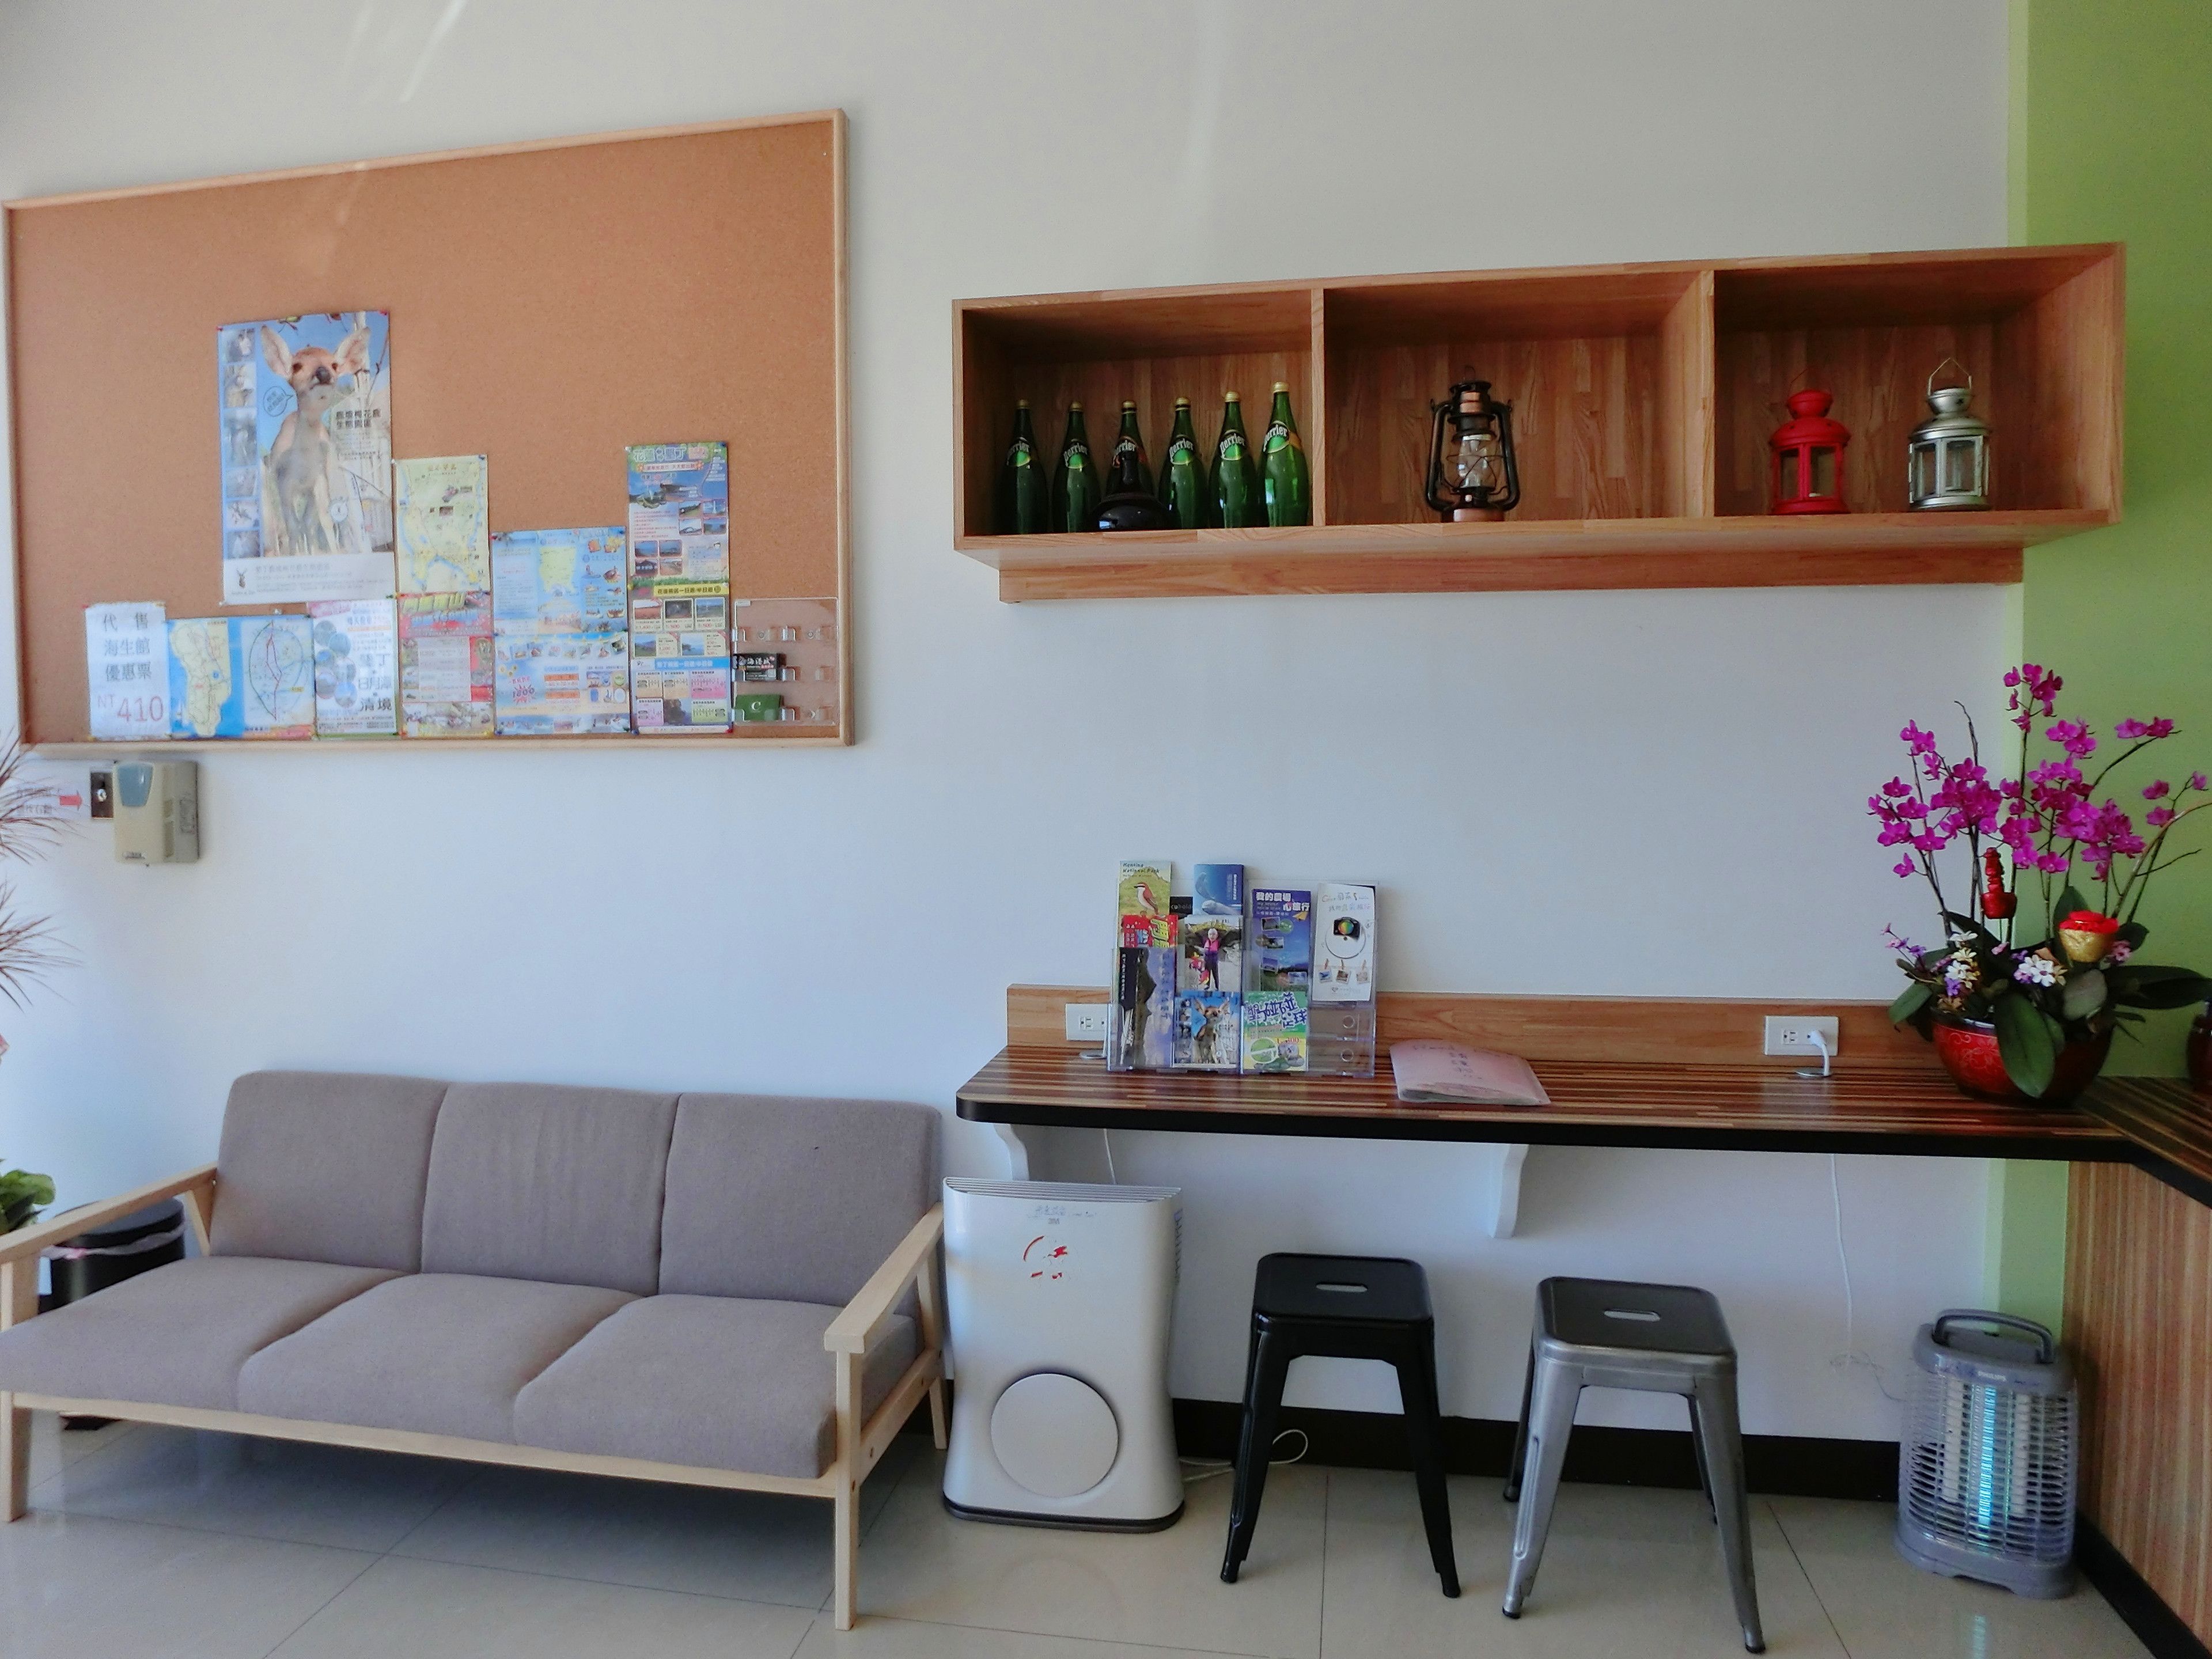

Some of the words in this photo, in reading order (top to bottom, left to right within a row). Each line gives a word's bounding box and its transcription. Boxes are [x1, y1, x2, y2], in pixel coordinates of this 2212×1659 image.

[103, 612, 149, 632] 代售
[104, 638, 151, 657] 海生館
[105, 662, 152, 683] 優惠票
[97, 694, 115, 709] NT
[117, 695, 164, 722] 410
